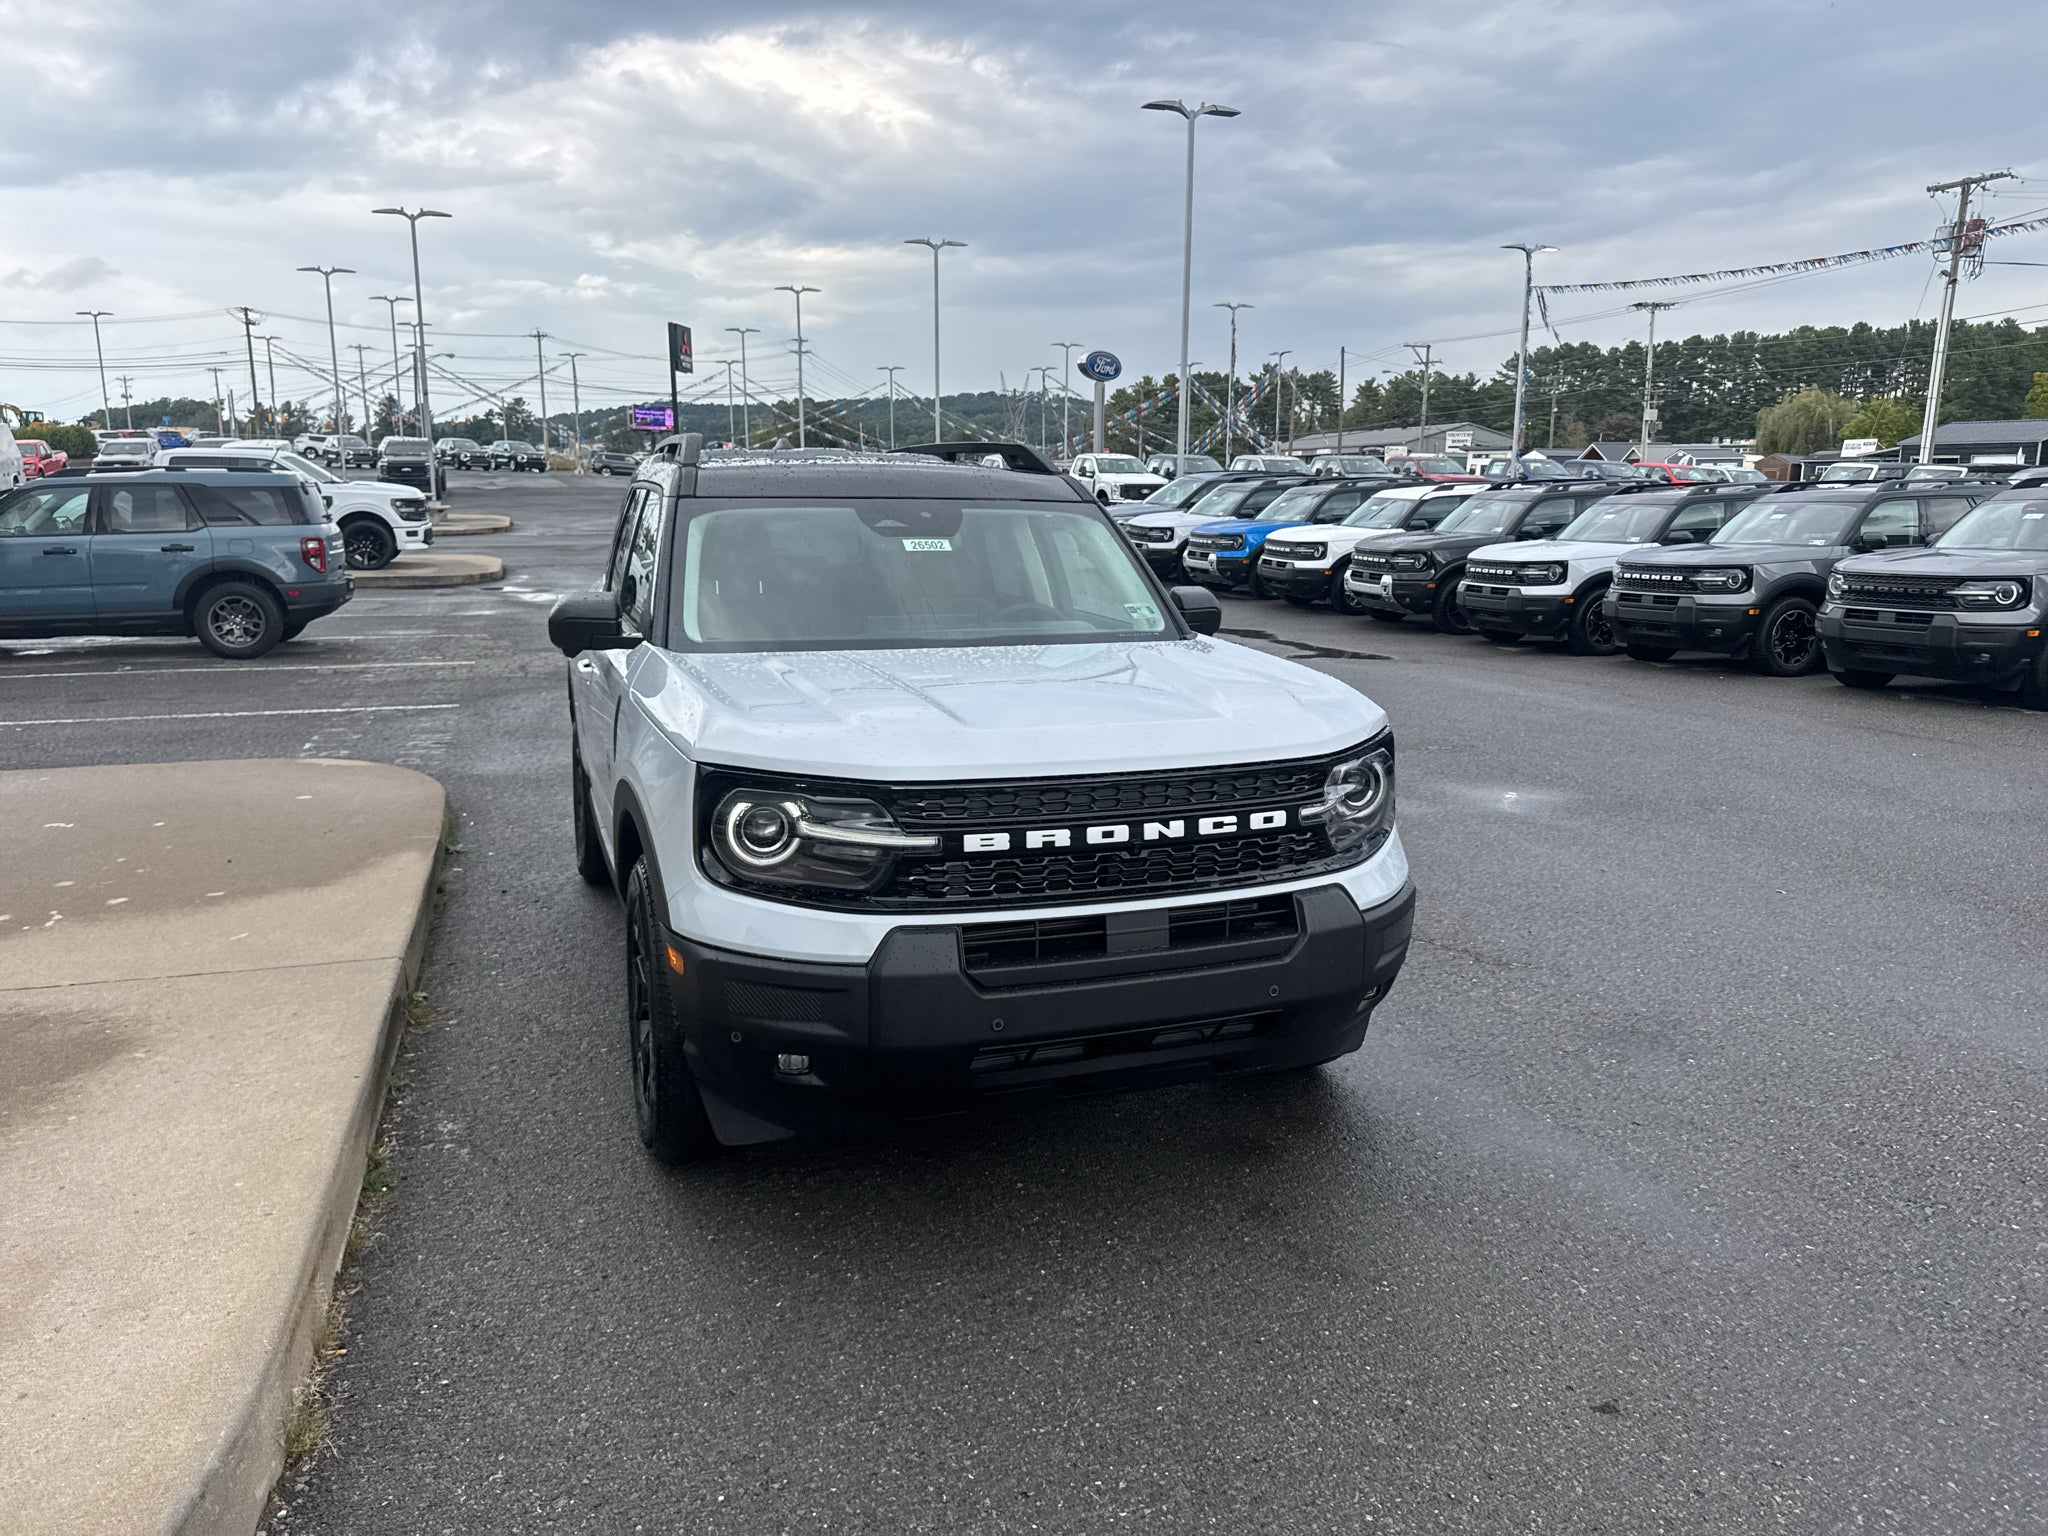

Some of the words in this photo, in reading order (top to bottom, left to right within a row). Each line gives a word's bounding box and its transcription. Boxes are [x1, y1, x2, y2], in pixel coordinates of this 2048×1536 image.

[1094, 355, 1116, 375] Ford
[910, 540, 945, 550] 26502
[1469, 567, 1513, 575] BRONCO
[1623, 573, 1683, 582] BRONCO
[1851, 585, 1938, 595] BRONCO
[963, 809, 1287, 853] BRONCO
